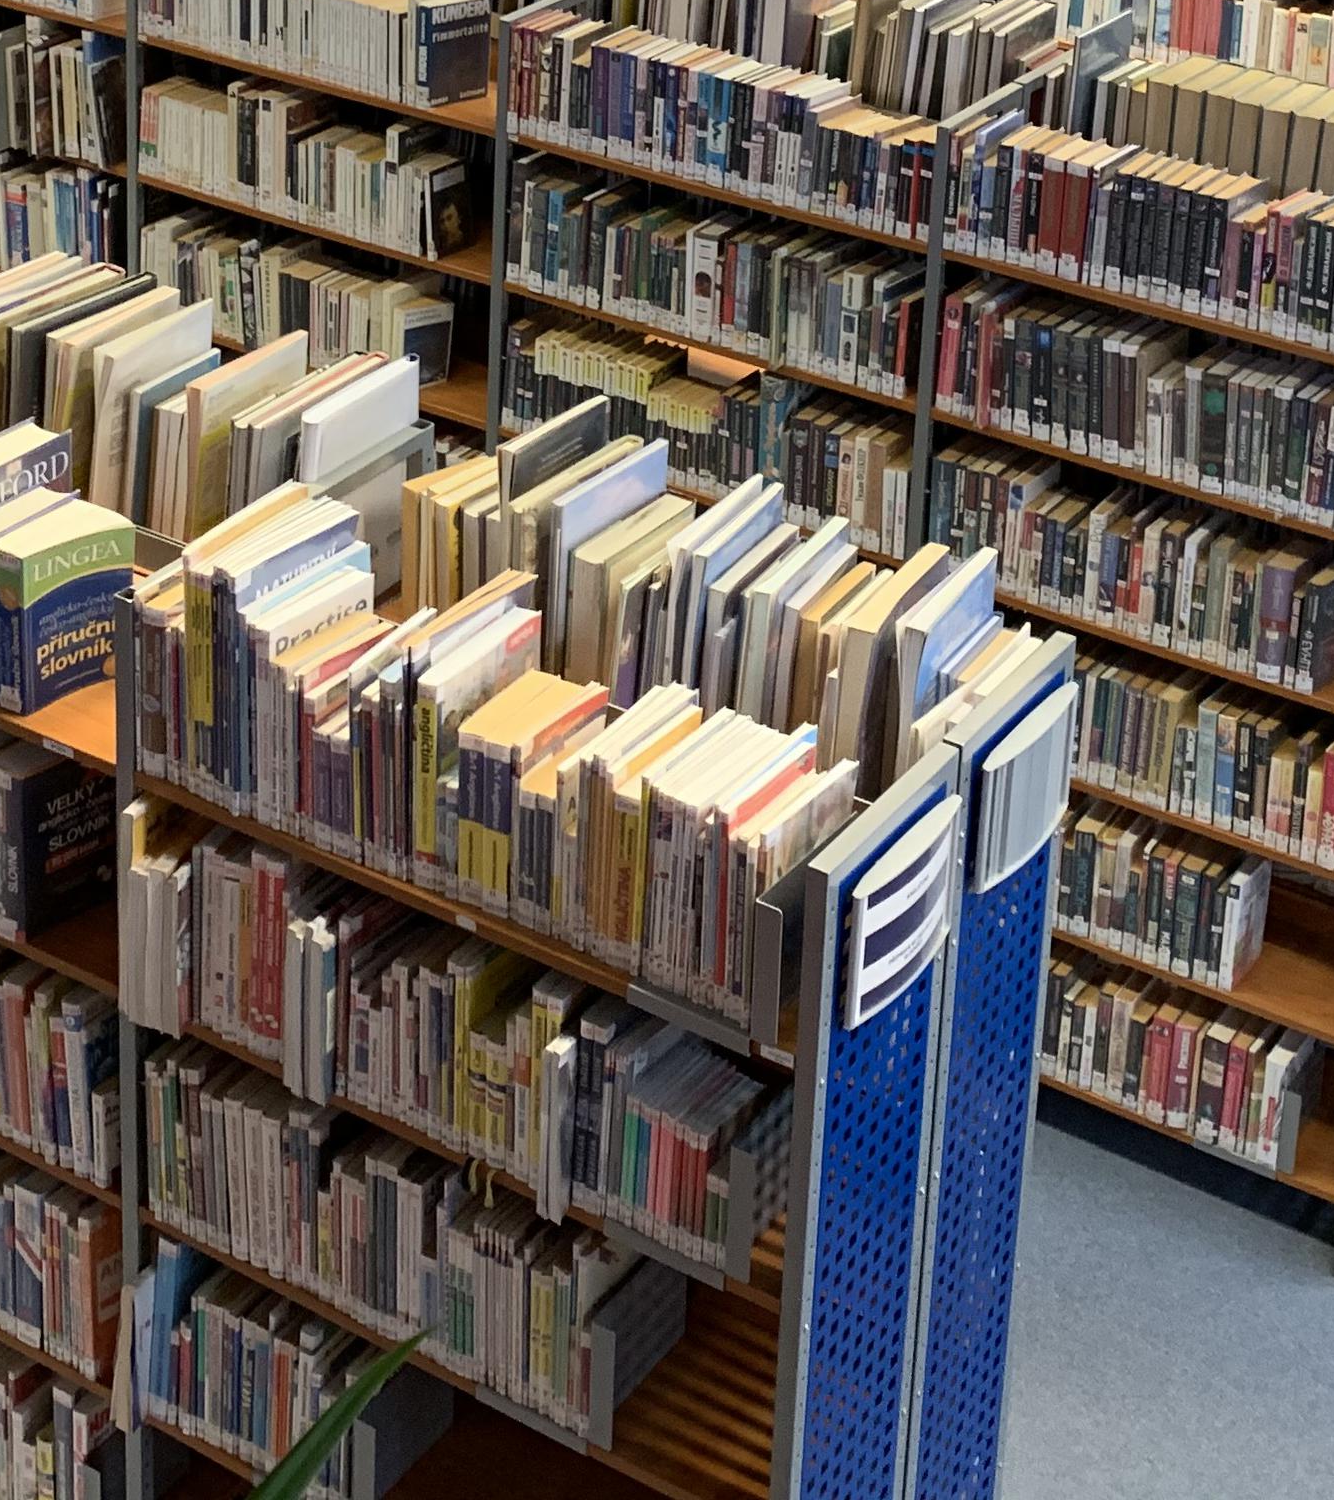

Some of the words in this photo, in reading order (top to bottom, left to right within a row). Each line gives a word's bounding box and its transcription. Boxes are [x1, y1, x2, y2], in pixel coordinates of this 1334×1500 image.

[431, 0, 492, 25] KUNDERA
[33, 538, 122, 583] LINGEA
[276, 599, 368, 656] Practice
[40, 641, 113, 680] slovník
[420, 707, 431, 774] angličtina
